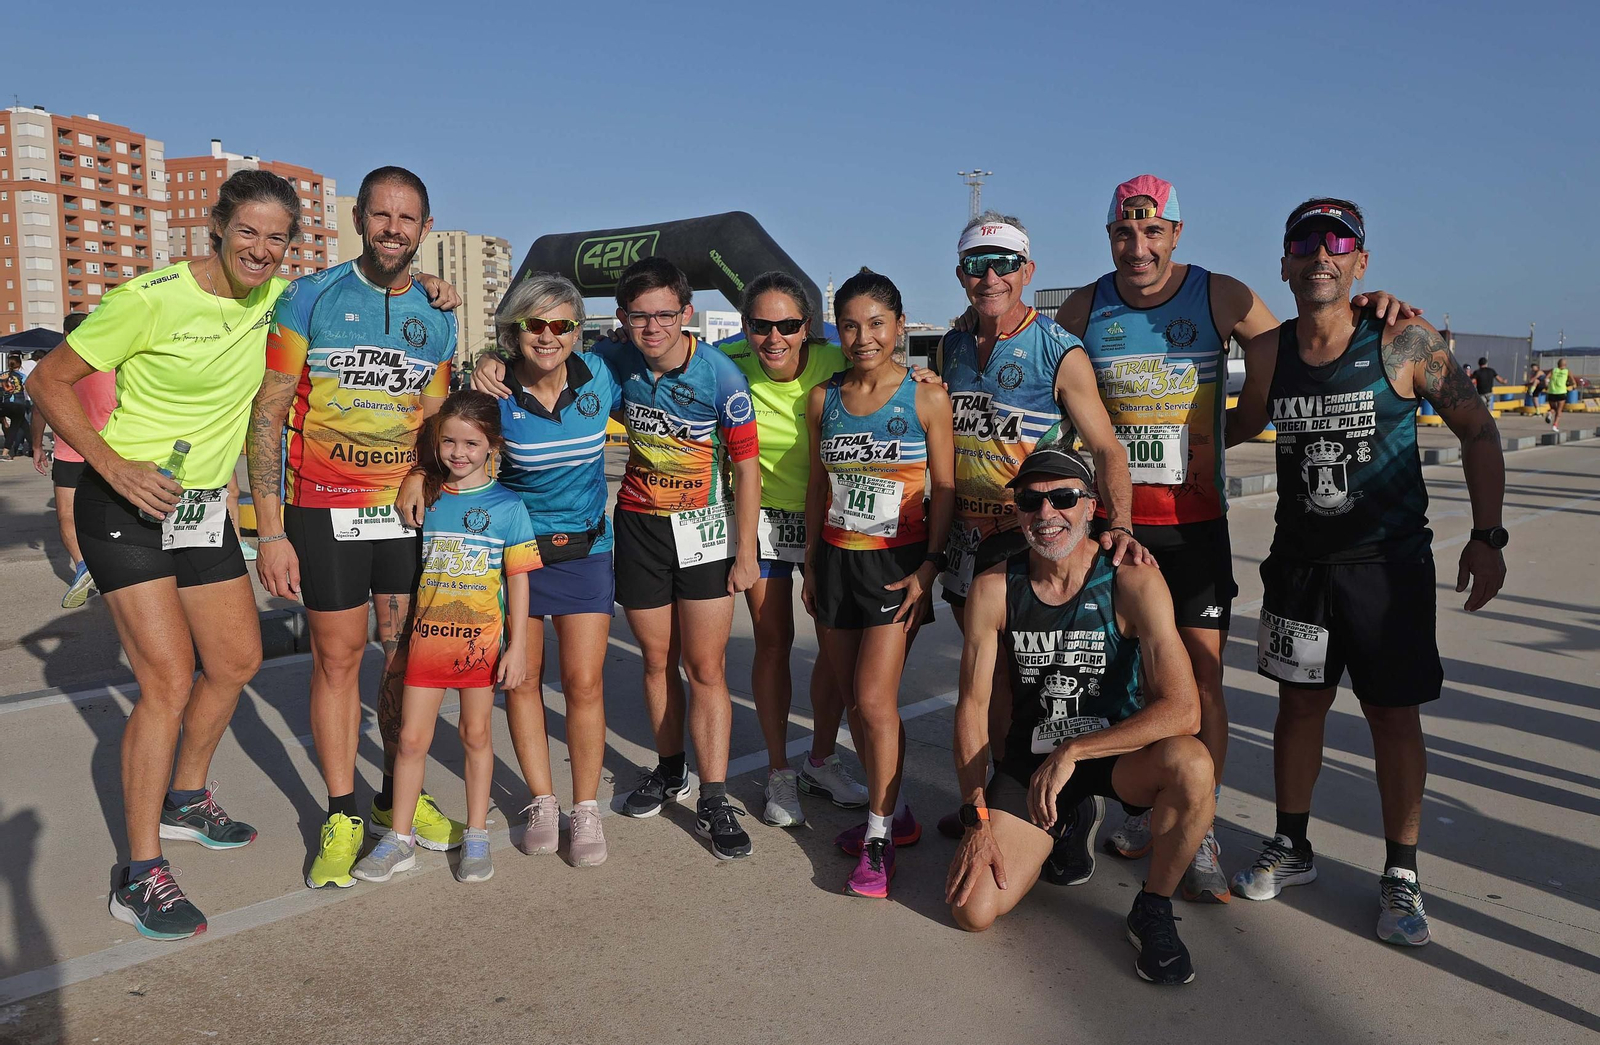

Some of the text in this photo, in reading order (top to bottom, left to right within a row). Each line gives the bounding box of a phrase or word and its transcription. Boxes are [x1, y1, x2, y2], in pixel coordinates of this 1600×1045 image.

[583, 239, 648, 269] 42K
[357, 349, 402, 368] TRAIL
[1114, 359, 1163, 379] TRAIL
[343, 370, 389, 387] TEAM
[1107, 366, 1198, 396] TEAM 3x4
[1120, 402, 1154, 411] Gabarras
[1164, 402, 1198, 410] Servicios
[1272, 390, 1373, 419] XXVI CARRERA
[1324, 401, 1375, 414] POPULAR
[629, 419, 658, 432] TEAM
[953, 416, 979, 432] EAM
[1115, 425, 1148, 434] XXVI
[1311, 418, 1332, 429] DEL
[1338, 414, 1373, 428] PILAR
[833, 434, 870, 449] TRAIL
[1346, 428, 1376, 439] 2024
[330, 443, 417, 467] Algeciras
[824, 442, 898, 462] TEAM 3x4
[978, 447, 984, 458] &
[1127, 440, 1164, 462] 100
[836, 473, 867, 484] XXVI
[848, 489, 876, 513] 141
[173, 504, 206, 525] 144
[678, 507, 711, 520] XXVI
[696, 519, 726, 542] 172
[777, 524, 807, 543] 138
[432, 539, 462, 552] TRAIL
[425, 551, 487, 574] EAM 3x4
[1012, 630, 1105, 652] XXVI CARRERA
[1063, 641, 1105, 650] POPULAR
[1270, 631, 1293, 658] 36
[1074, 653, 1104, 665] PILAR
[1079, 666, 1106, 675] 2024
